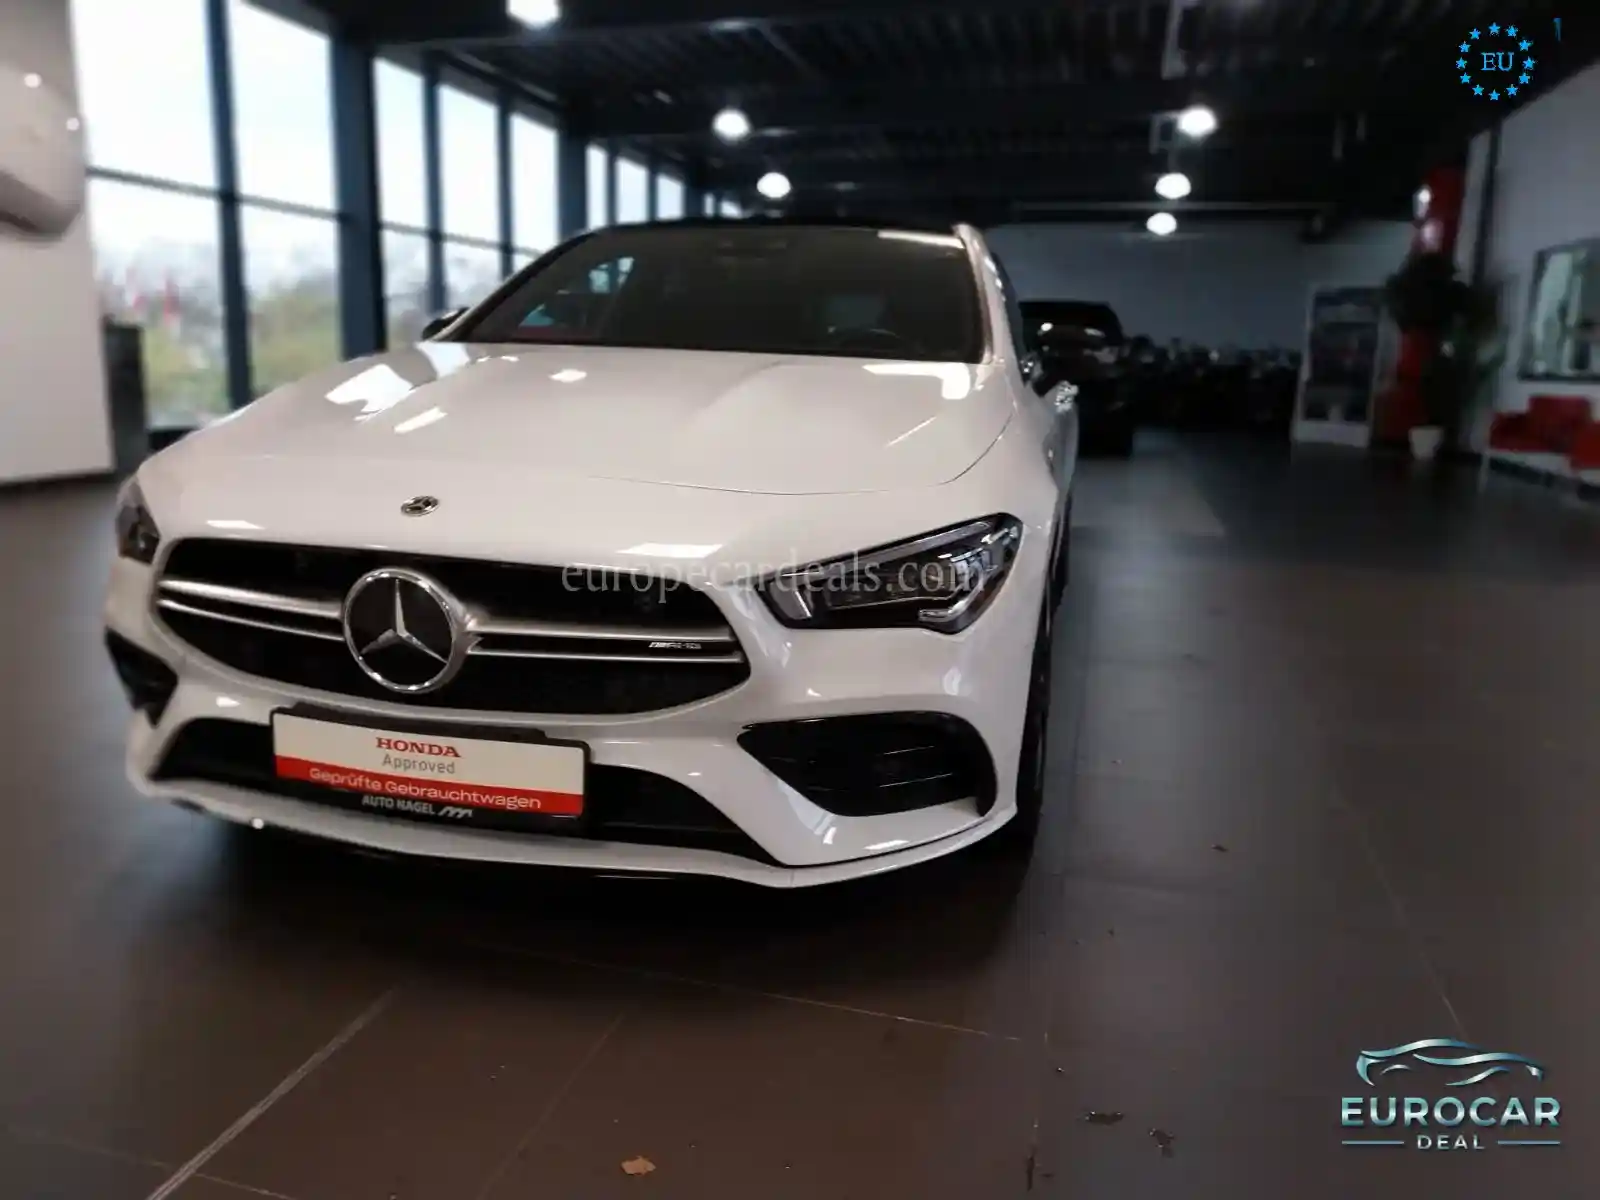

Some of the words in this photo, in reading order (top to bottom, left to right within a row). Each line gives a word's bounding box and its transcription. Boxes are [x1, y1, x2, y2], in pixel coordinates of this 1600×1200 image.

[375, 737, 461, 758] HONDA
[382, 753, 456, 774] Approved
[309, 767, 382, 791] Geprüfte
[385, 781, 542, 811] Gebrauchtwagen
[362, 795, 394, 809] AUTO
[396, 799, 436, 816] NAGEL
